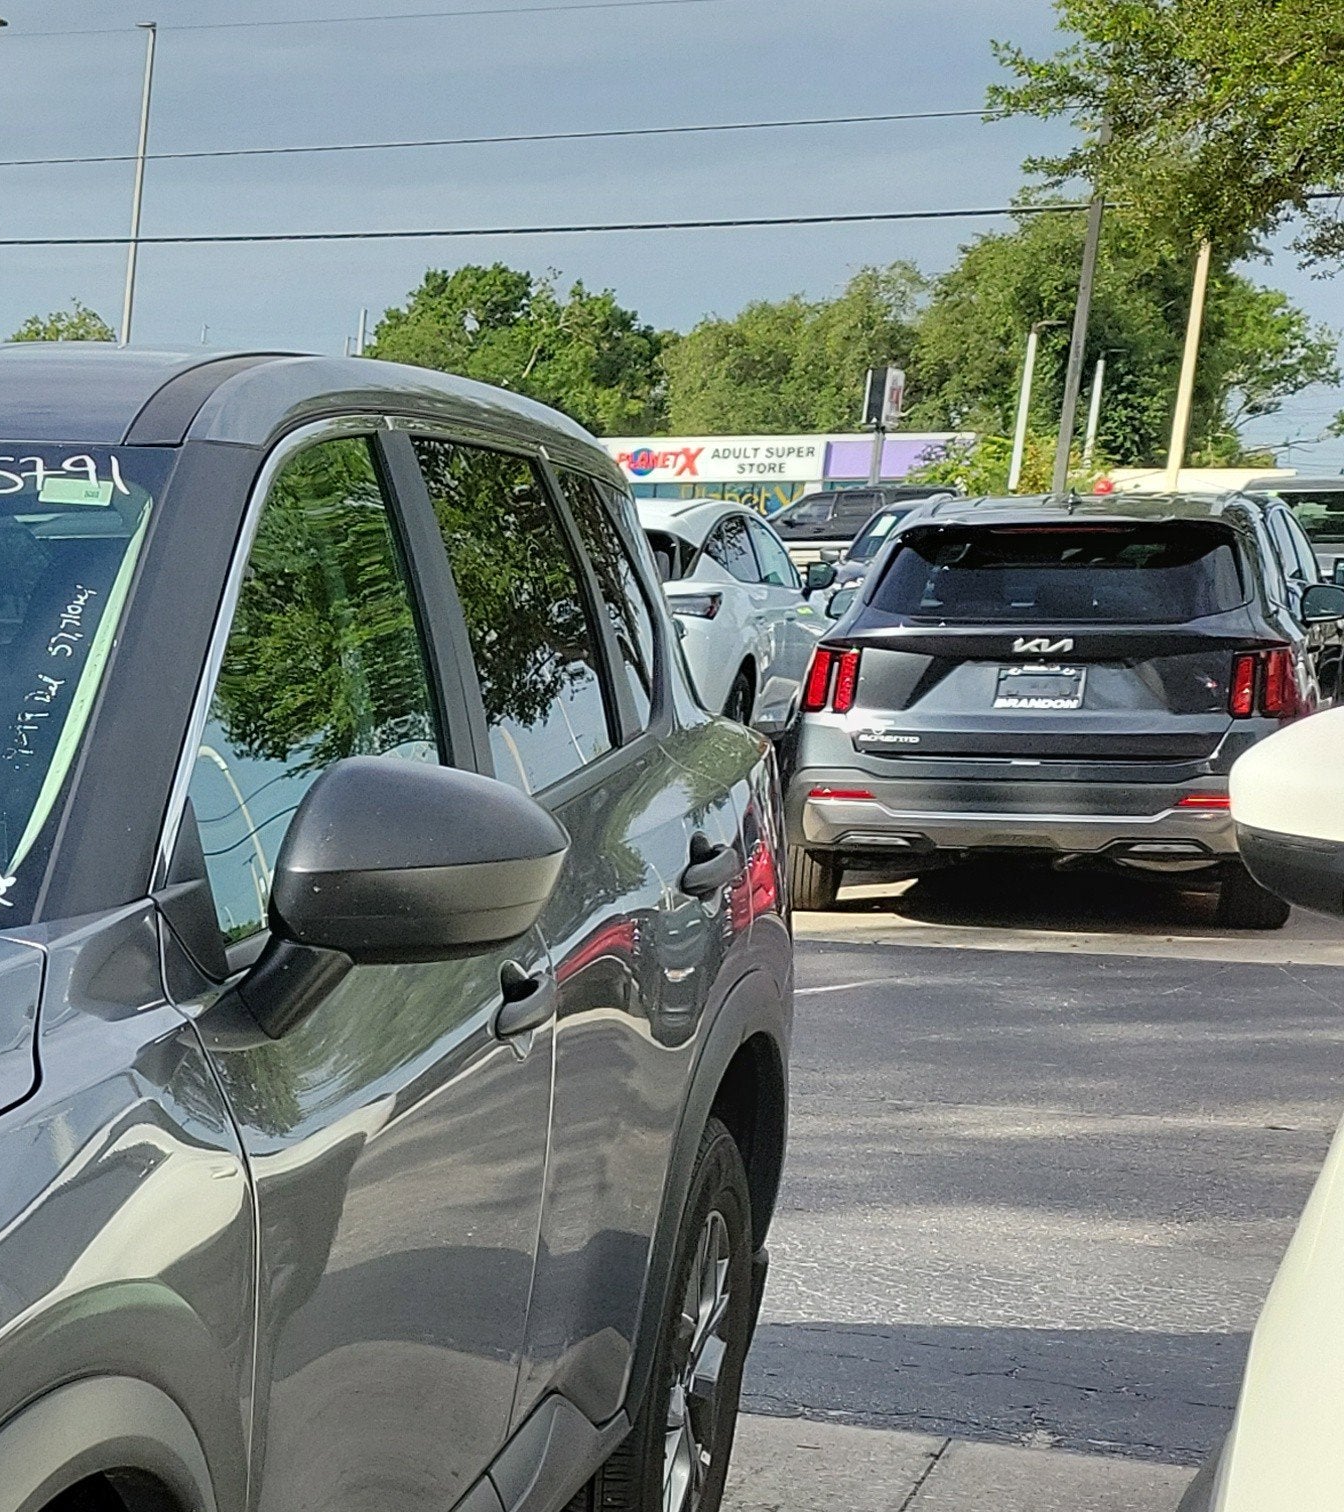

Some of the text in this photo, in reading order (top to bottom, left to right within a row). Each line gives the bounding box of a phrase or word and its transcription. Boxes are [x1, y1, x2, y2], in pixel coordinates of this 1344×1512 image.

[615, 445, 816, 477] PLANET X ADULT SUPER
[736, 462, 787, 475] STORE
[1012, 637, 1074, 653] KIA
[993, 698, 1080, 709] BRANDON
